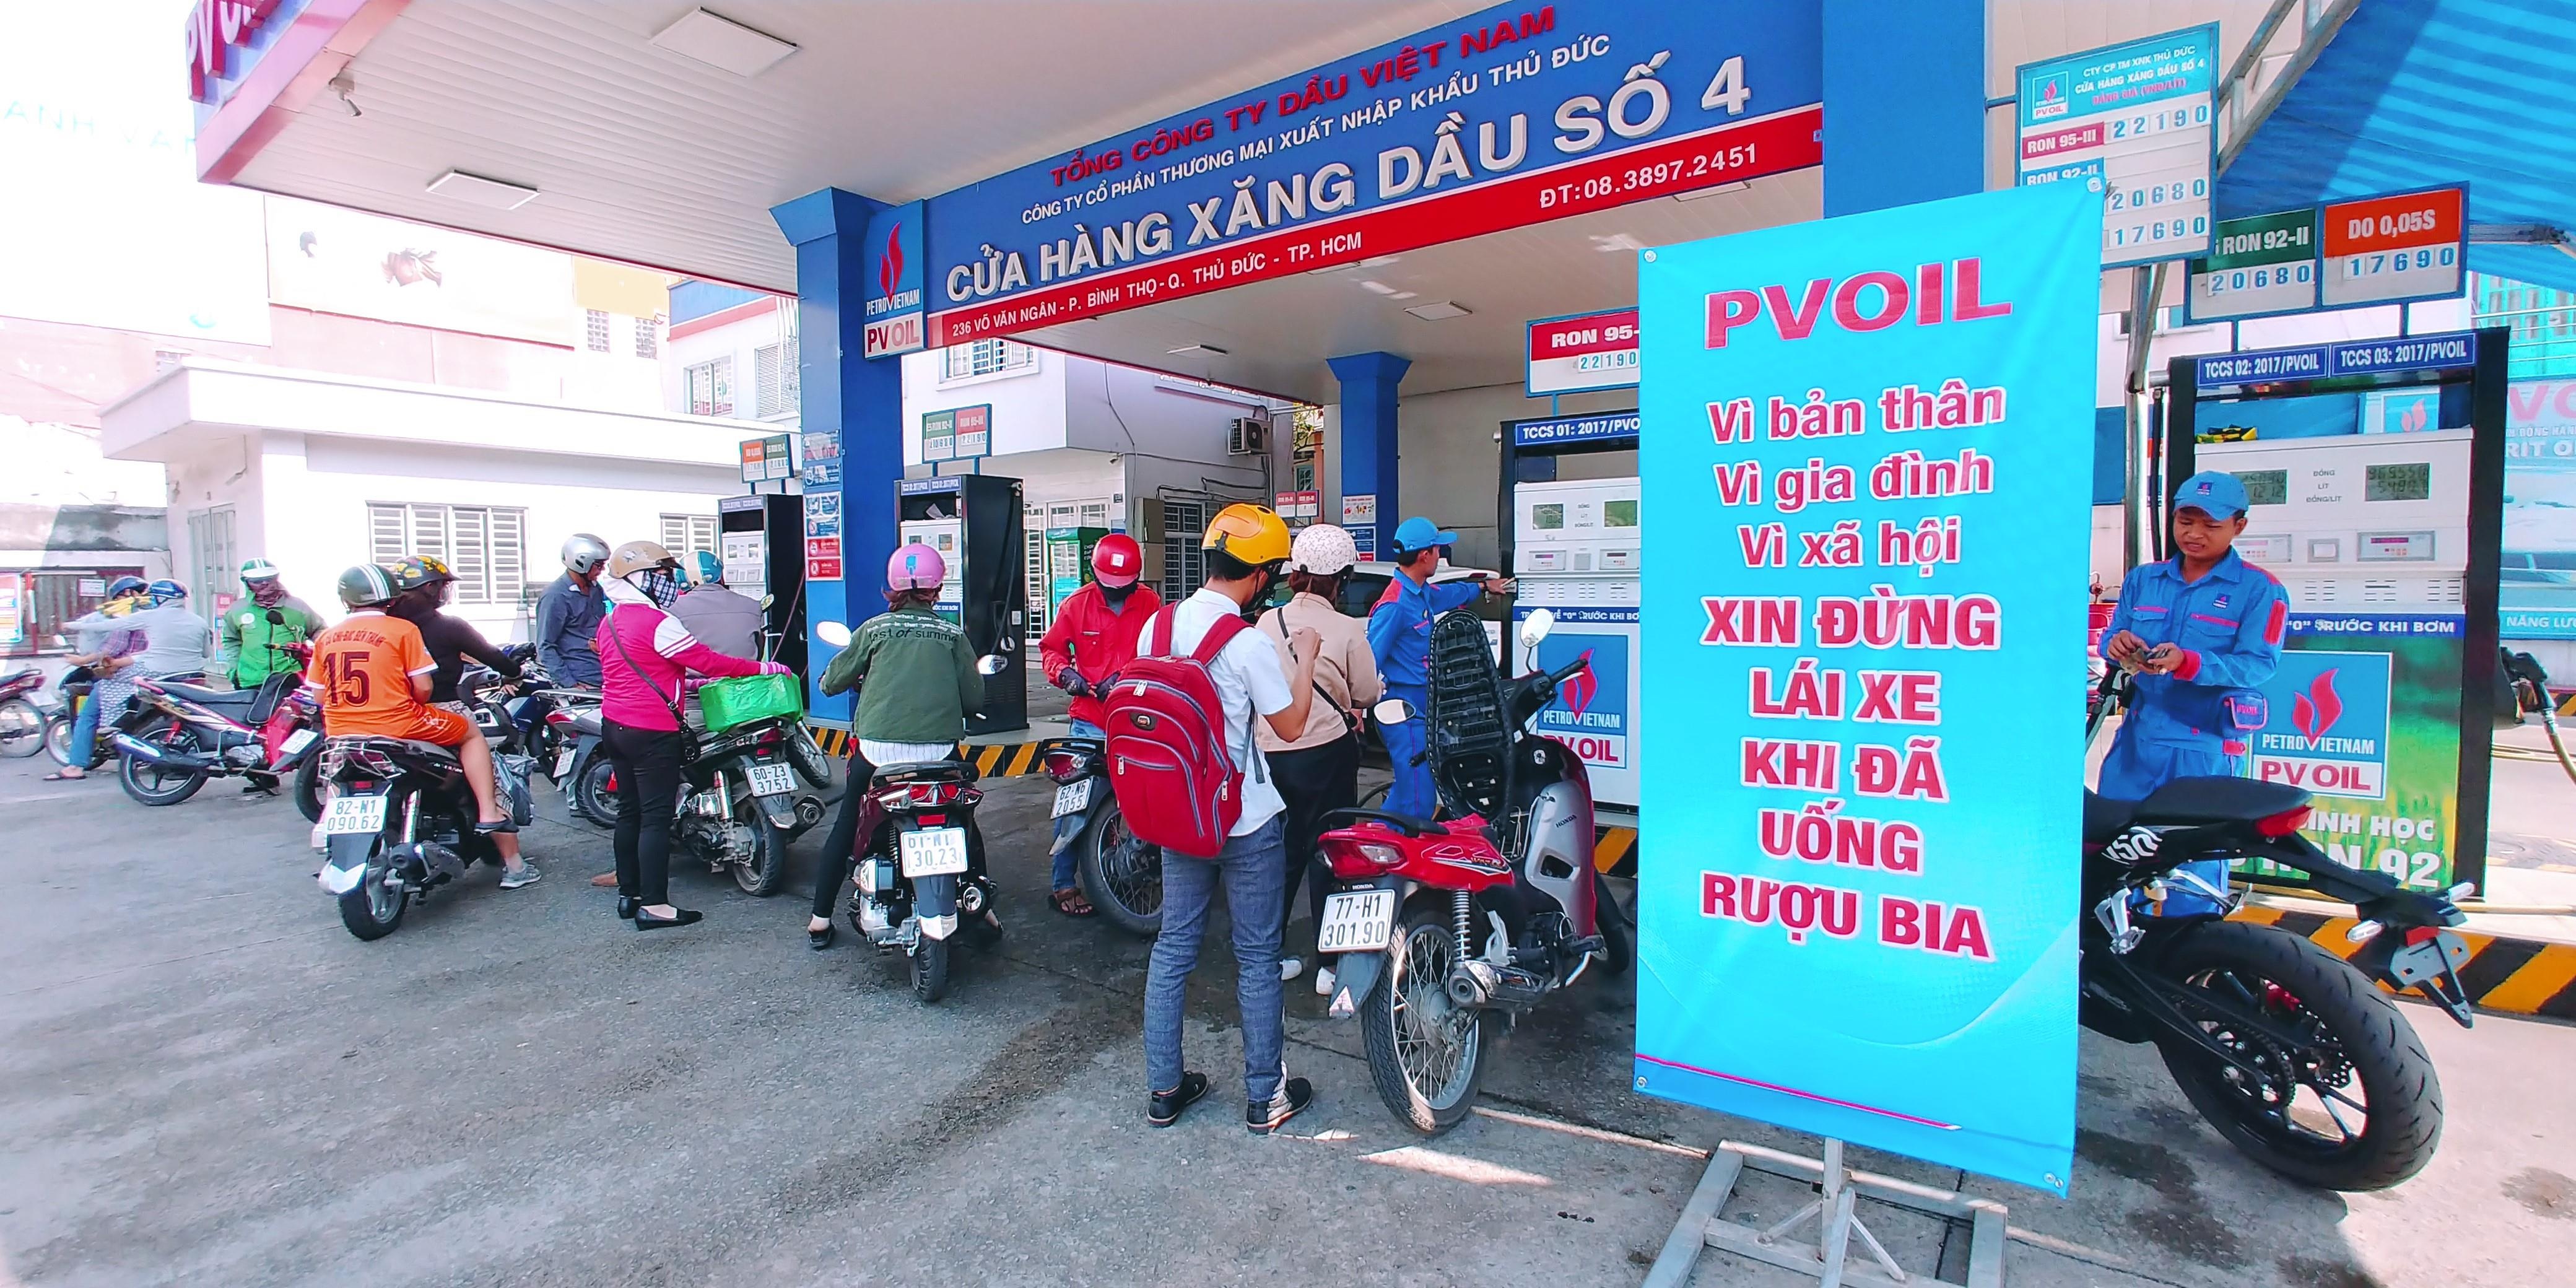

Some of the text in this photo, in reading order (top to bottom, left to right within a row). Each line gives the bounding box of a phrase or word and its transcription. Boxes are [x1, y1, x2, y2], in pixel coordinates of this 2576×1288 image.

[2084, 67, 2100, 77] CTY
[2104, 64, 2115, 73] CP
[2118, 60, 2130, 70] TM
[2131, 56, 2151, 67] XNK
[2198, 58, 2204, 67] 4
[1050, 5, 1556, 187] TỔNG CÔNG TY DẦU VIỆT NAM
[1022, 33, 1610, 224] CÔNG TY CỔ PHẦN THƯƠNG MẠI XUẤT NHẬP KHẨU THỦ ĐỨC
[2113, 105, 2207, 138] 22190
[2027, 129, 2096, 154] RON 95-III
[945, 50, 1752, 302] CỬA HÀNG XĂNG DẦU SỐ 4
[2112, 178, 2205, 210] 20680
[2115, 216, 2205, 245] 17690
[2348, 209, 2435, 239] DO 0,05S
[2223, 234, 2261, 255] RON
[2264, 226, 2308, 250] 92-II
[2349, 247, 2454, 277] 17690
[952, 320, 972, 337] 236
[975, 314, 990, 332] VÕ
[993, 310, 1016, 327] VĂN
[1020, 302, 1057, 321] NGÂN
[1069, 298, 1081, 313] P.
[1087, 287, 1119, 307] BÌNH
[1126, 278, 1157, 298] THỌ
[1193, 256, 1224, 283] THỦ
[1230, 252, 1266, 276] ĐỨC
[1287, 241, 1315, 263] TP.
[1321, 232, 1362, 255] HCM
[2211, 264, 2310, 292] 20680
[866, 296, 920, 316] PETROVIETNAM
[1704, 256, 2013, 350] PVOIL
[1552, 324, 1639, 348] RON 95-
[1580, 351, 1637, 370] 22190
[2205, 352, 2318, 379] TCCS 02: 2017/PVOIL
[2341, 340, 2466, 367] TCCS 03: 2017/PVOIL
[1707, 378, 2006, 443] Vì bản thân
[1523, 417, 1640, 439] TCCS 01: 2017/PVO
[1713, 448, 1993, 513] Vì gia đình
[1738, 516, 1961, 578] Vì xã hội
[1627, 612, 1640, 620] BƠ
[1700, 583, 2001, 650] XIN ĐỪNG
[2378, 620, 2408, 632] KHI
[2413, 619, 2454, 633] BƠM
[896, 627, 914, 638] of
[324, 651, 370, 708] 15
[1749, 657, 1941, 725] LÁI XE
[1543, 710, 1621, 729] PETROVIETNAM
[2261, 734, 2375, 755] PETROVIETNAM
[754, 765, 786, 780] 60-Z3
[1741, 734, 1950, 803] KHI ĐÃ
[757, 778, 790, 793] 3752
[1057, 796, 1082, 814] 2055
[326, 814, 381, 832] 090.62
[1556, 814, 1577, 829] HONDA
[2370, 816, 2435, 846] HỌC
[1757, 799, 1924, 876] UỐNG
[2378, 848, 2440, 888] 92
[1335, 894, 1381, 920] 77-H1
[1700, 869, 1998, 963] RƯỢU BIA
[1324, 921, 1385, 947] 301.90
